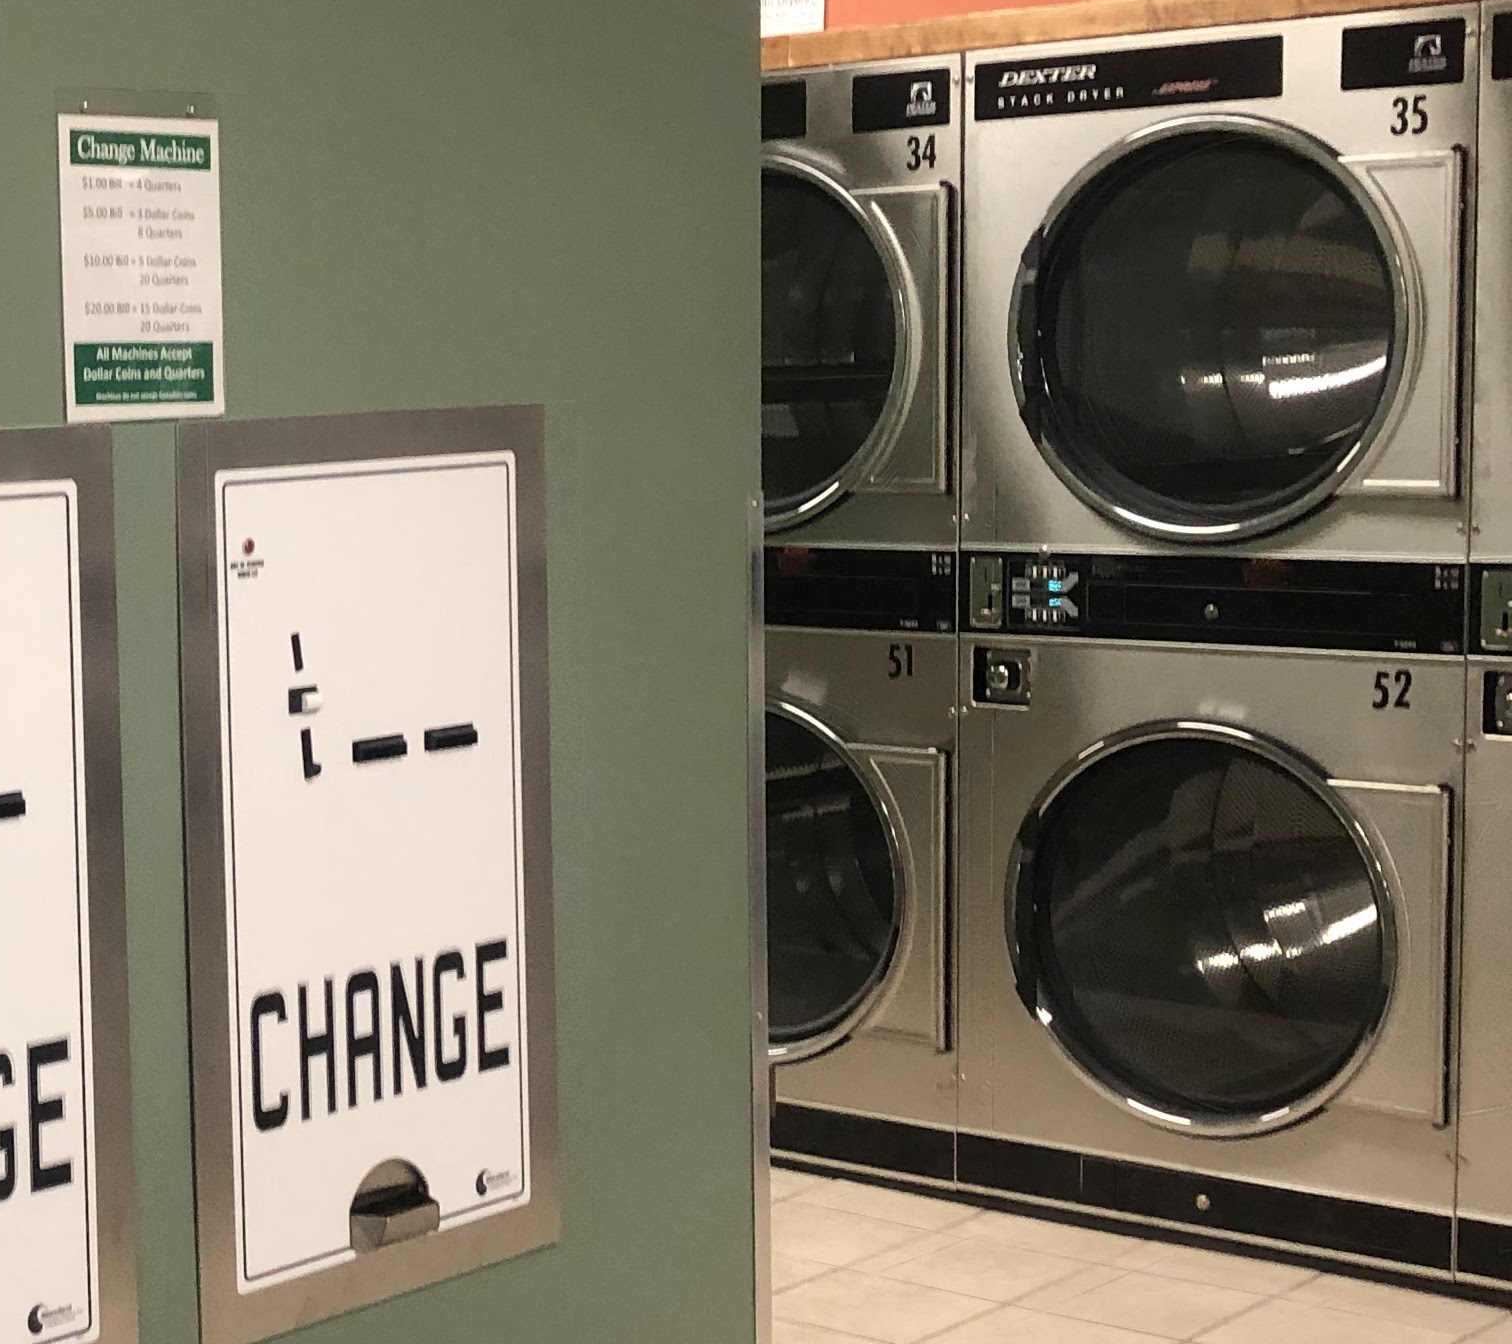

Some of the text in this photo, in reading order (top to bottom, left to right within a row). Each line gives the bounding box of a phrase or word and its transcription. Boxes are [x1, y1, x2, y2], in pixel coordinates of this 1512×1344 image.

[998, 64, 1097, 88] DEXTER
[998, 92, 1054, 109] STACK
[1390, 96, 1429, 135] 35
[77, 134, 205, 166] Change Machine
[906, 134, 937, 170] 34
[96, 346, 192, 362] All Machines Accept
[83, 365, 205, 382] Dollar Coins and Quarters
[888, 644, 914, 679] 51
[1372, 669, 1413, 709] 52
[250, 938, 510, 1133] CHANGE
